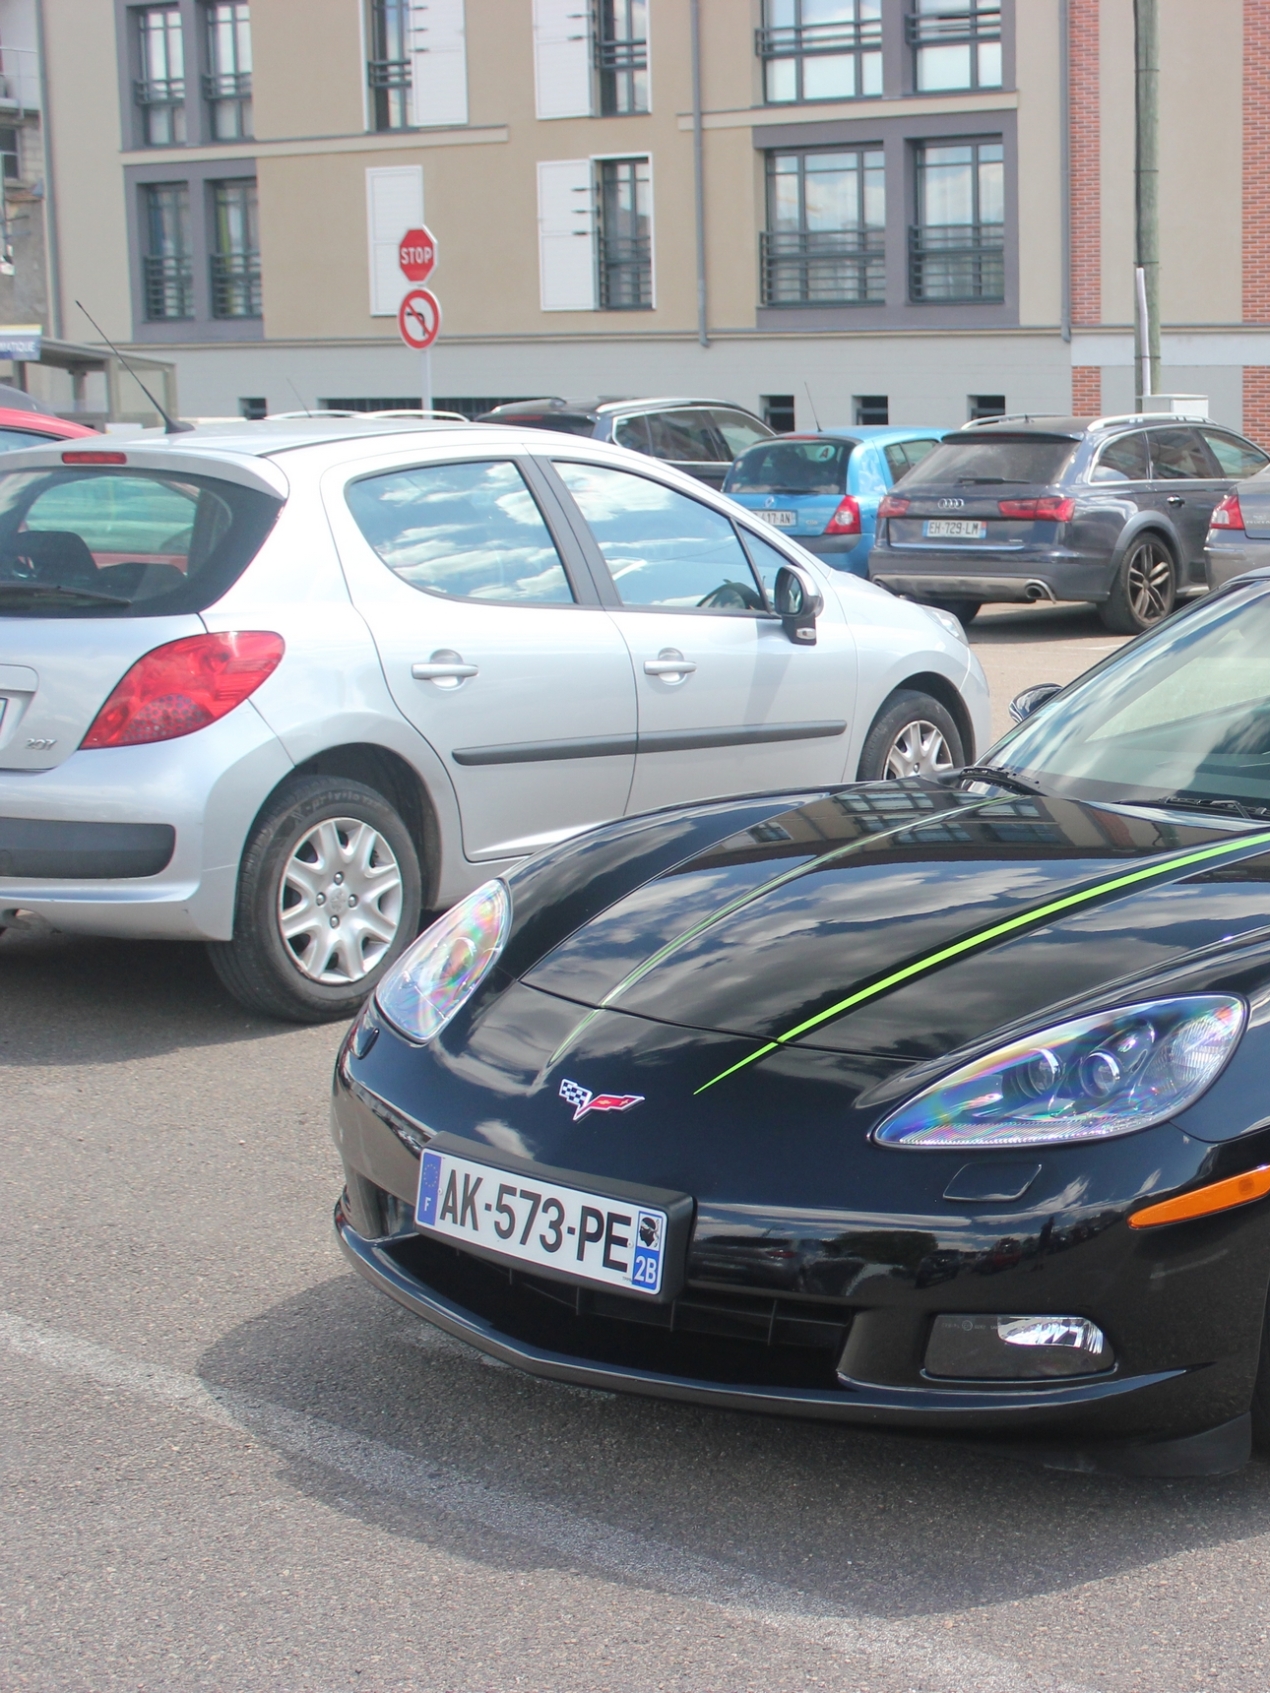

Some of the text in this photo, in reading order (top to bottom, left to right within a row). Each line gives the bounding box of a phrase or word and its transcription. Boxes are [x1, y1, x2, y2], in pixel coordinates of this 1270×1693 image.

[400, 247, 432, 265] STOP
[820, 447, 830, 459] A
[929, 521, 979, 535] EH-729-LM
[25, 738, 57, 751] 207
[424, 1197, 431, 1212] F
[440, 1169, 632, 1273] AK-573-PE
[634, 1255, 657, 1284] 2B
